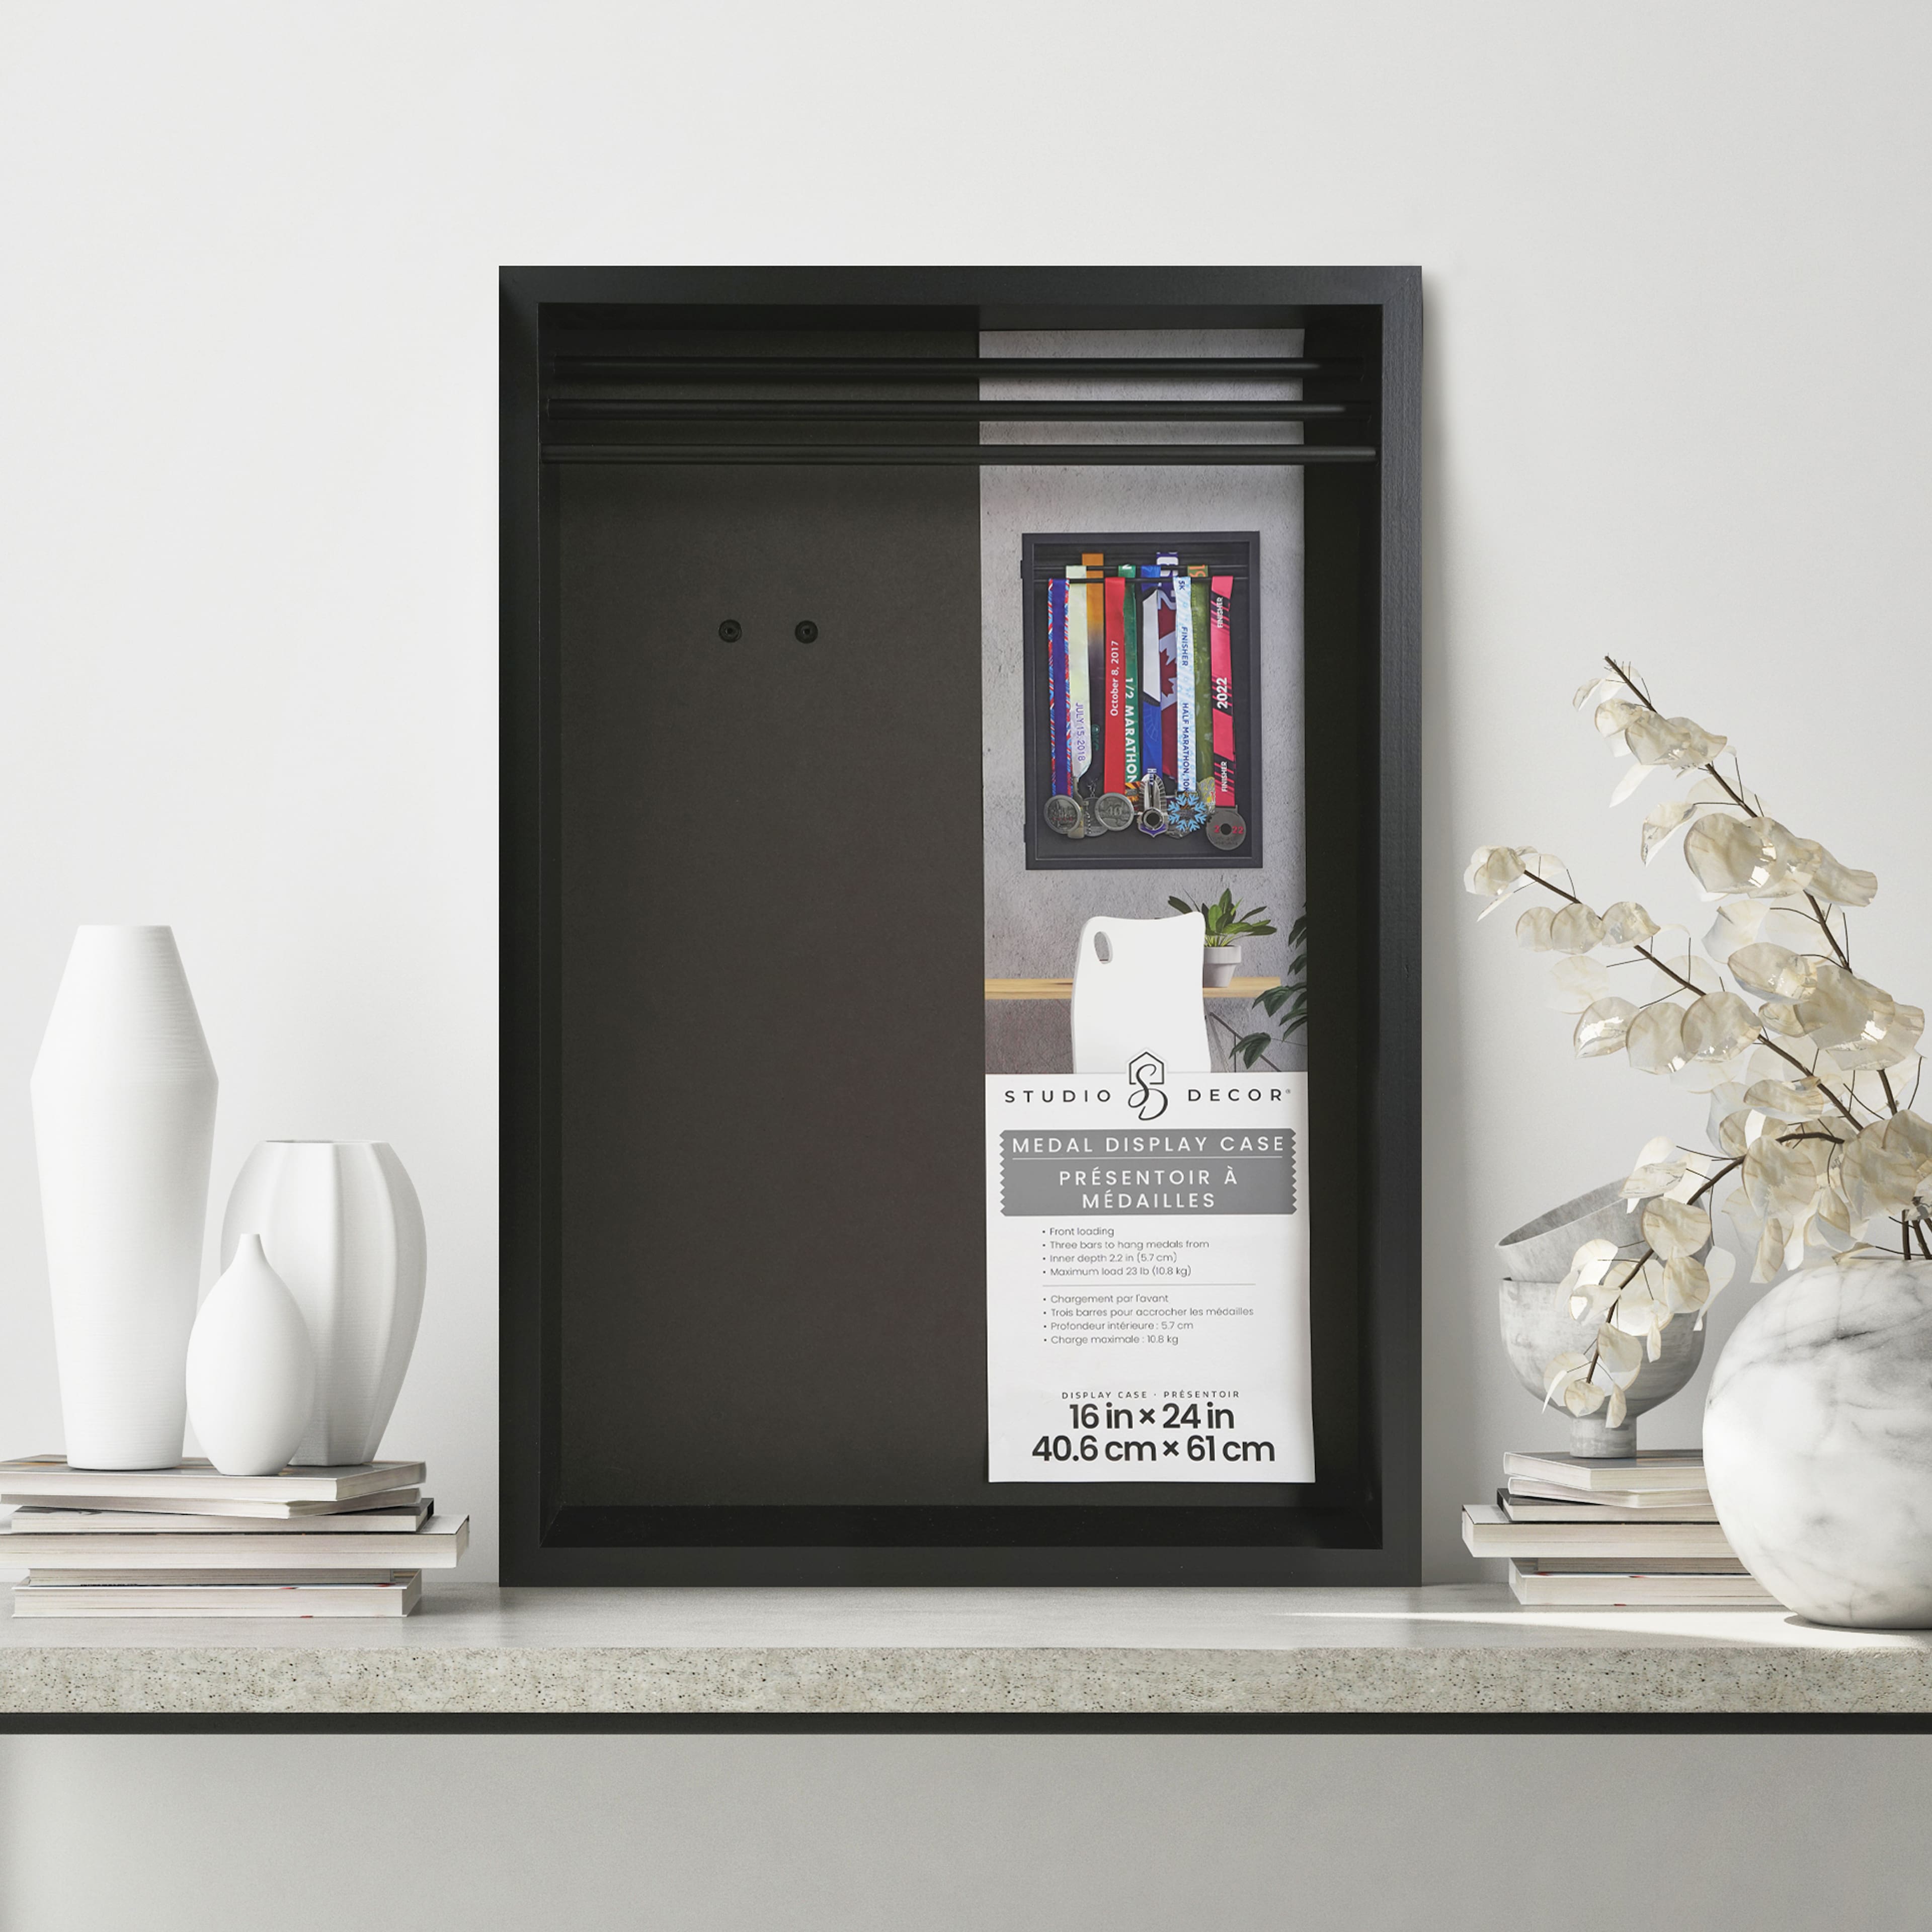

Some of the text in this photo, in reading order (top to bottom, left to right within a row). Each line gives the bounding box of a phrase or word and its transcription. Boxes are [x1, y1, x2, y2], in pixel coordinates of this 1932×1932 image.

[1111, 640, 1119, 664] 2017
[1110, 678, 1119, 716] October
[1216, 677, 1228, 709] 2022
[1076, 702, 1084, 723] JULY
[1125, 678, 1137, 782] 1/2 MARATHON
[1077, 740, 1086, 761] 2018
[1005, 1090, 1110, 1102] STUDIO
[1013, 1137, 1282, 1152] MEDAL DISPLAY CASE
[1060, 1166, 1237, 1185] PRÉSENTOIR À
[1083, 1190, 1214, 1208] MÉDAILLES
[1077, 1228, 1114, 1238] loading
[1118, 1242, 1143, 1251] hang
[1077, 1255, 1106, 1264] depth
[1110, 1254, 1122, 1262] 2.2
[1138, 1252, 1154, 1263] (5.7
[1156, 1252, 1176, 1263] cm)
[1126, 1267, 1137, 1275] 23
[1152, 1266, 1173, 1276] (10.8
[1176, 1265, 1191, 1277] kg)
[1051, 1294, 1168, 1305] Chargement par l'avant
[1110, 1310, 1133, 1318] pour
[1136, 1308, 1186, 1316] accrocher
[1161, 1321, 1174, 1329] 5.7
[1051, 1336, 1088, 1346] Charge
[1091, 1335, 1139, 1343] maximale
[1167, 1335, 1178, 1345] kg
[1070, 1404, 1099, 1429] 16
[1106, 1402, 1133, 1428] in
[1163, 1403, 1201, 1428] 24
[1207, 1402, 1234, 1428] in
[1032, 1435, 1098, 1461] 40.6
[1105, 1441, 1156, 1461] cm
[1188, 1435, 1215, 1461] 61
[1223, 1441, 1274, 1461] cm
